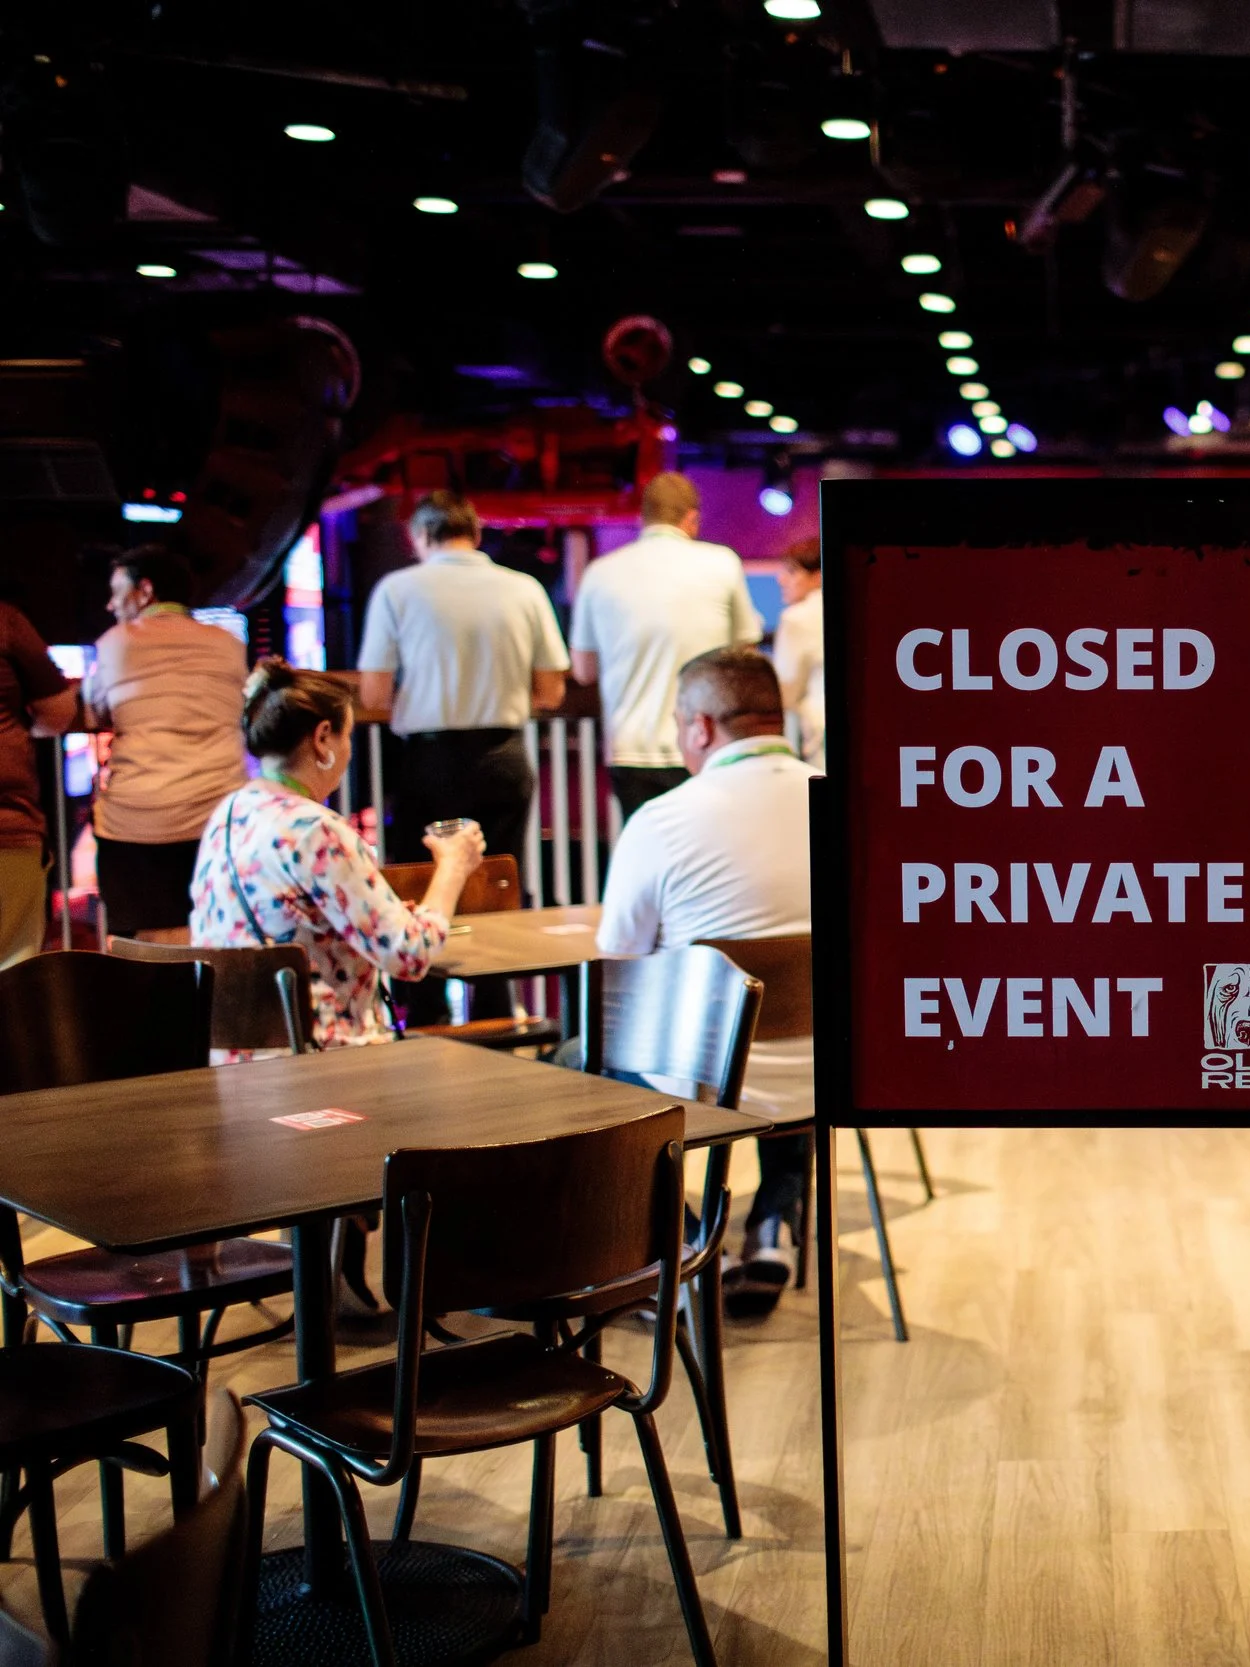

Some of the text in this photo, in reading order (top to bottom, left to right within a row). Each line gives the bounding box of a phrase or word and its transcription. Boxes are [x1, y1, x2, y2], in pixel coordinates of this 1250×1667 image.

[896, 628, 1215, 690] CLOSED
[900, 746, 1145, 807] FOR A
[902, 863, 1243, 923] PRIVATE
[904, 977, 1163, 1038] EVENT
